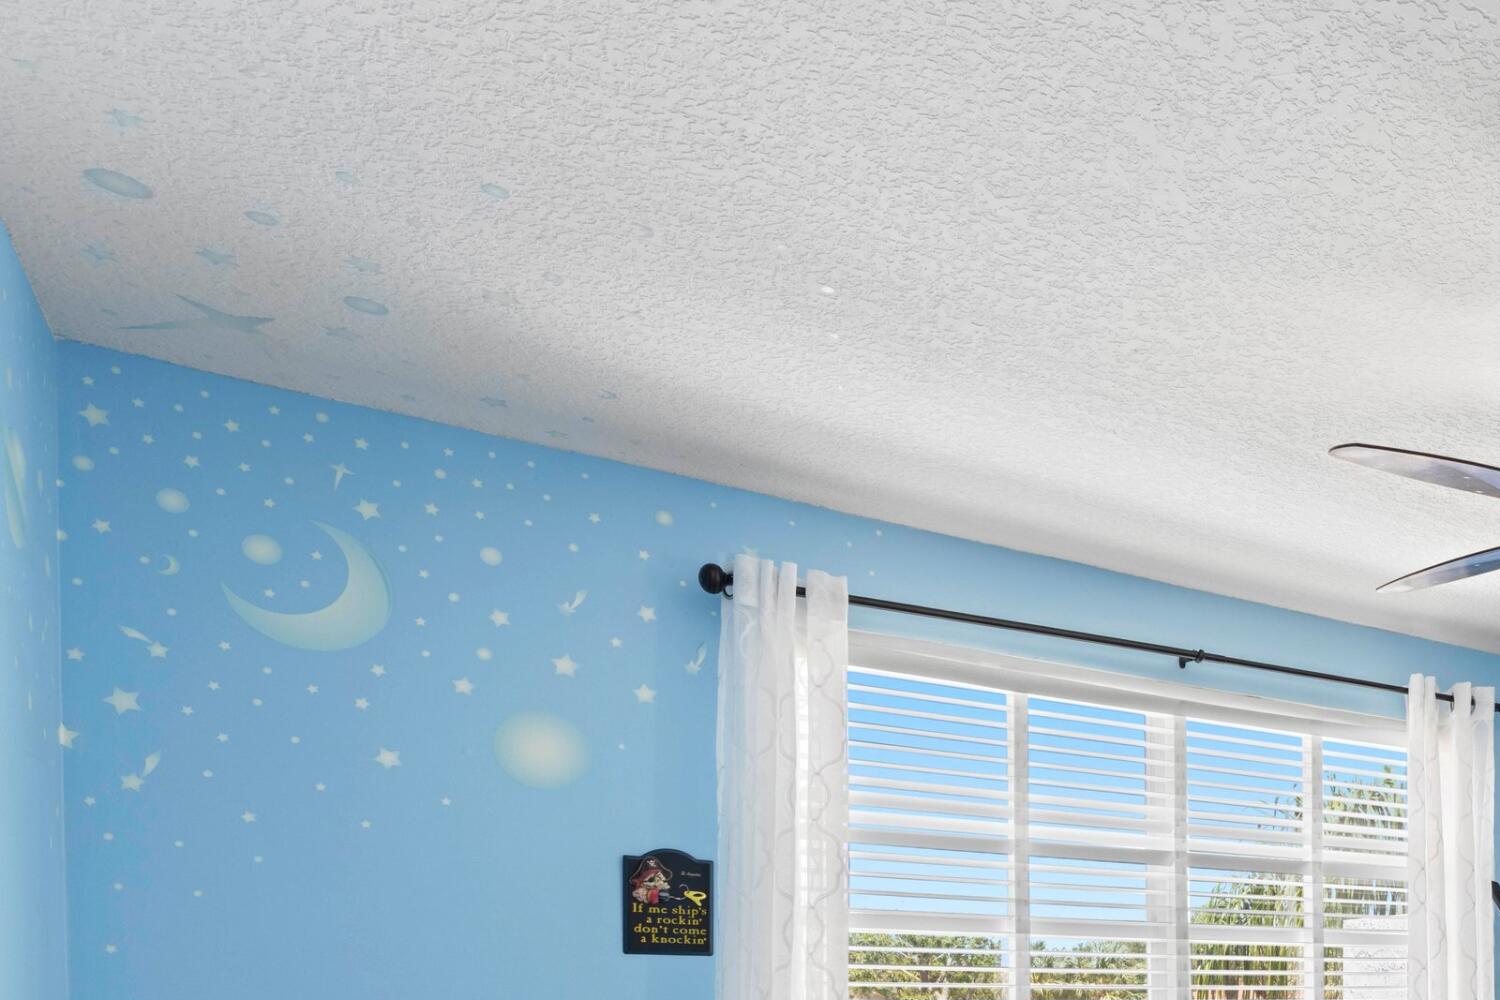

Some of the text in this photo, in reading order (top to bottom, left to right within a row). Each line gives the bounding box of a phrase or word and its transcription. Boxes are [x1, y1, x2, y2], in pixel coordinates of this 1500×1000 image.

[632, 903, 643, 913] If
[671, 905, 707, 918] ship's
[657, 915, 702, 925] rockin'
[634, 924, 707, 935] don't come
[652, 933, 707, 945] knockin'
